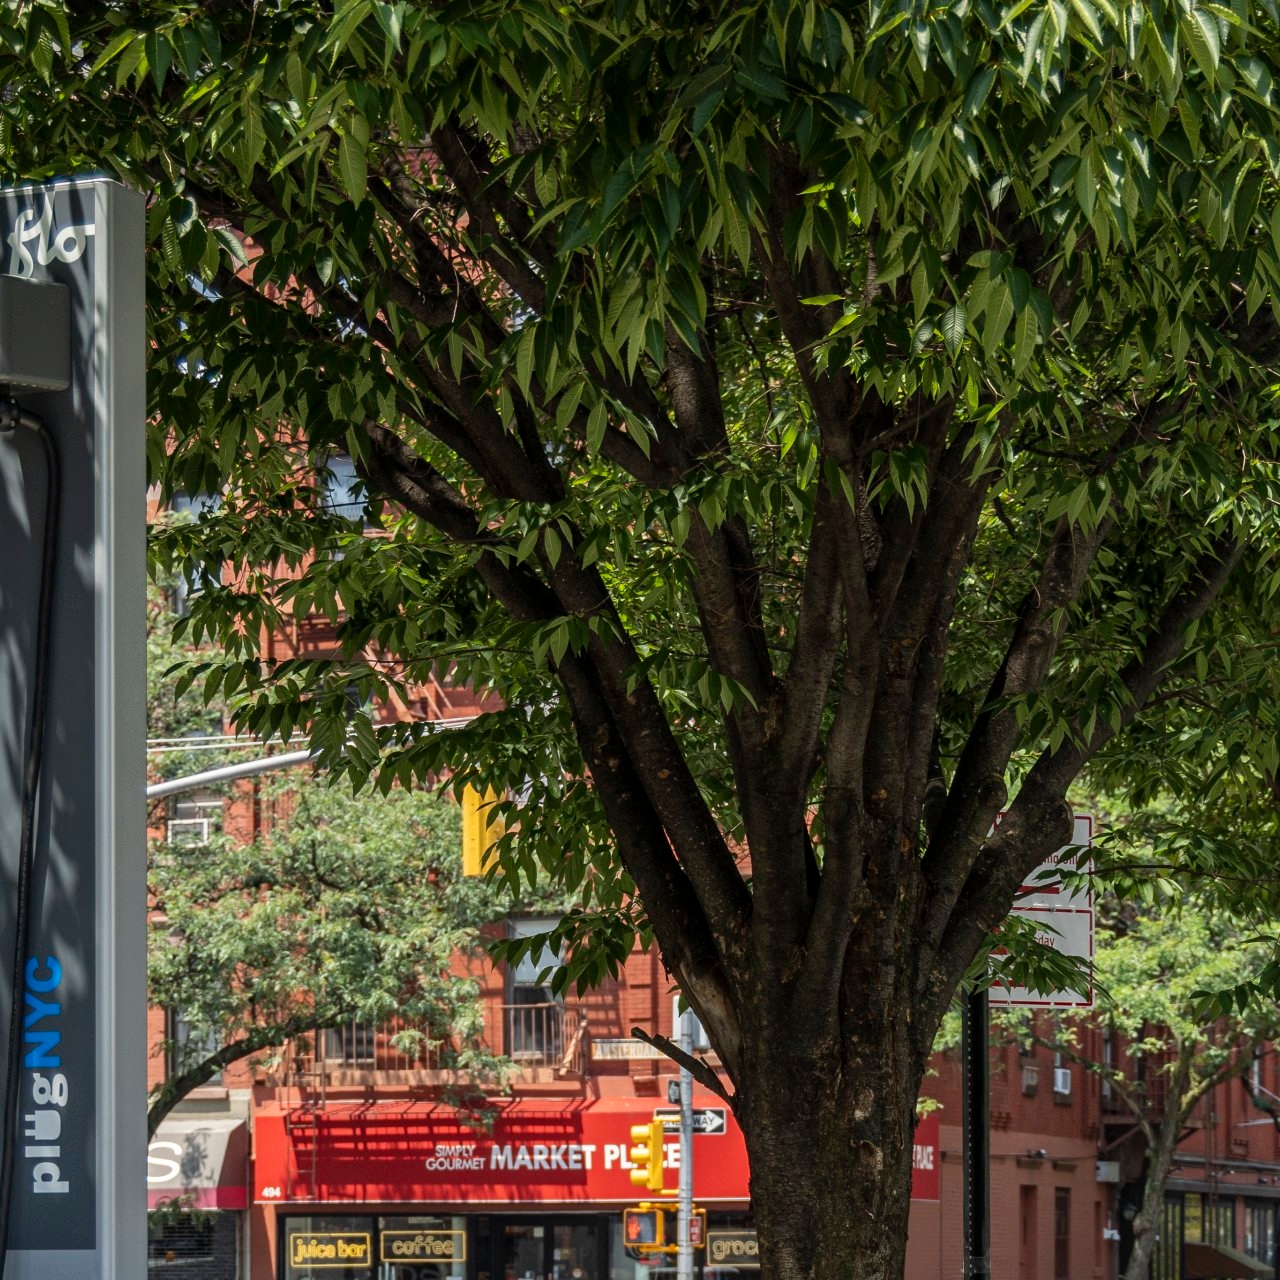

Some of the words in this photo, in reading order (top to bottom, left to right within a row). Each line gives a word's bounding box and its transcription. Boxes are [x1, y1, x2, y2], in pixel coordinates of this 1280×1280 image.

[6, 184, 96, 280] flo
[693, 1115, 715, 1126] WAY
[435, 1144, 476, 1158] SIMPLY
[489, 1144, 596, 1170] MARKET
[604, 1143, 681, 1170] PLE
[425, 1157, 486, 1171] GOURMET
[261, 1186, 282, 1198] 494
[294, 1238, 336, 1263] juice
[337, 1239, 367, 1258] bar
[391, 1235, 455, 1256] coffee
